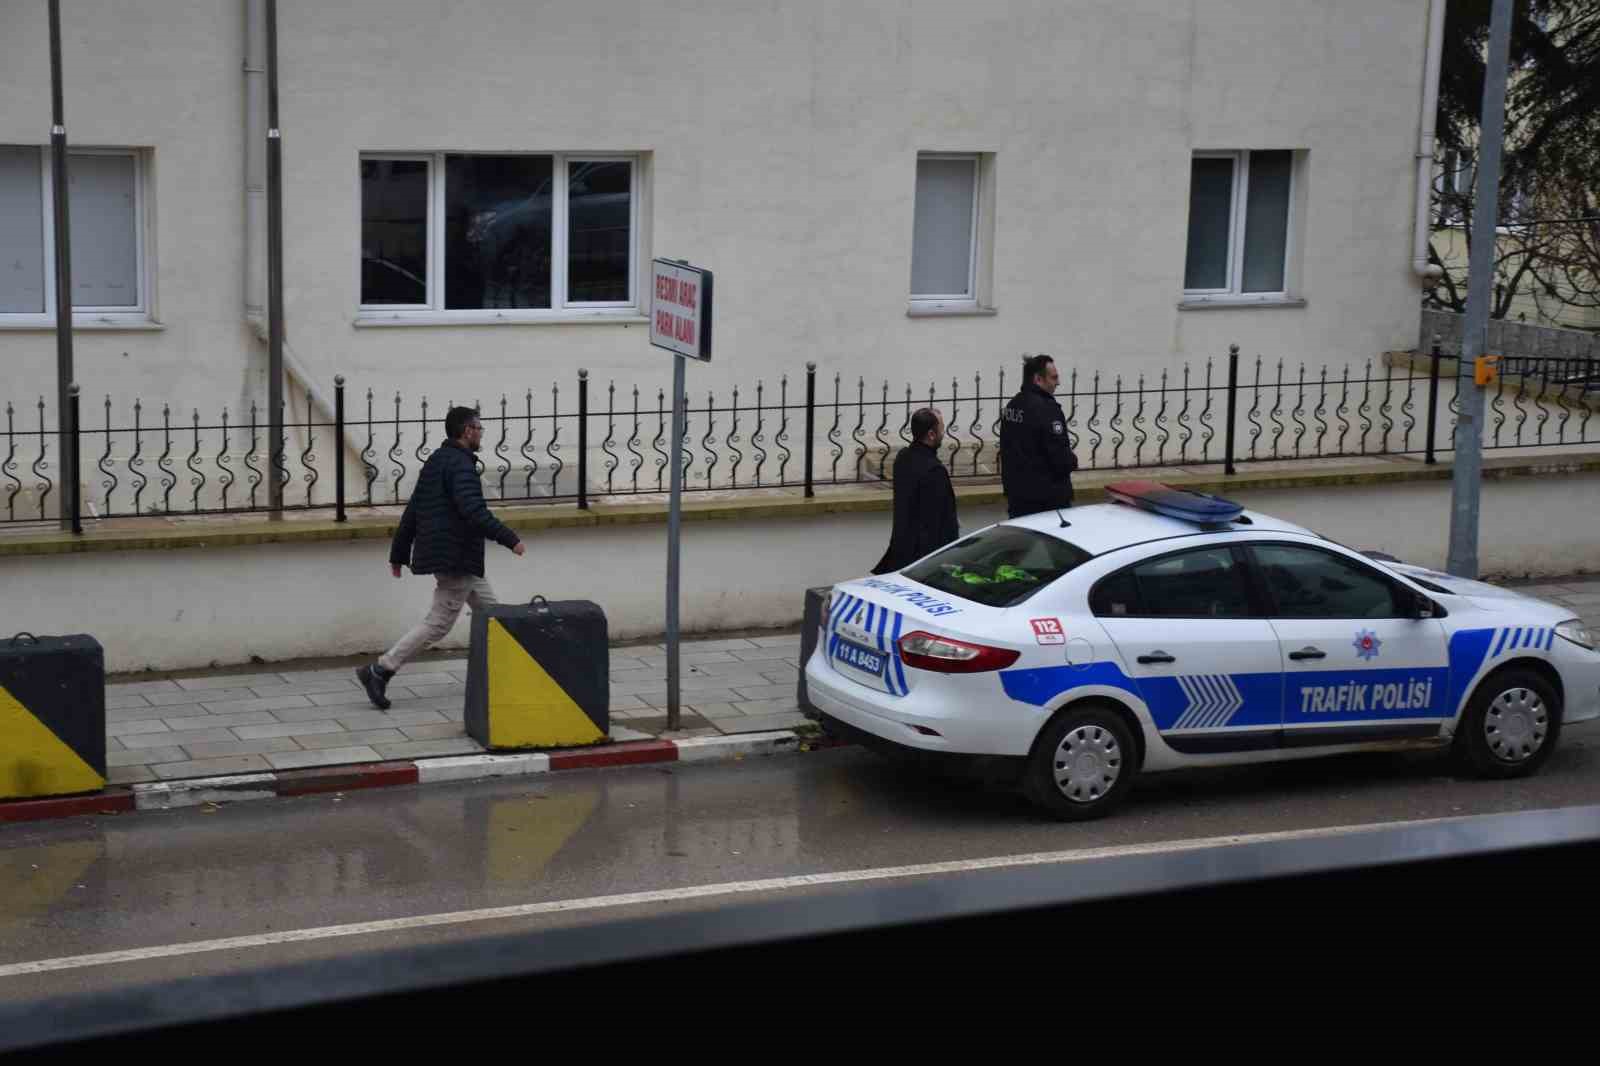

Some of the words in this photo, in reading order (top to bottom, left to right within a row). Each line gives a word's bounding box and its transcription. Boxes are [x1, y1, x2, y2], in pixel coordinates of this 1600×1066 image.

[656, 310, 673, 337] PARK
[1035, 620, 1057, 633] 112
[1301, 680, 1368, 713] TRAFİK
[1371, 677, 1433, 709] POLİSİ
